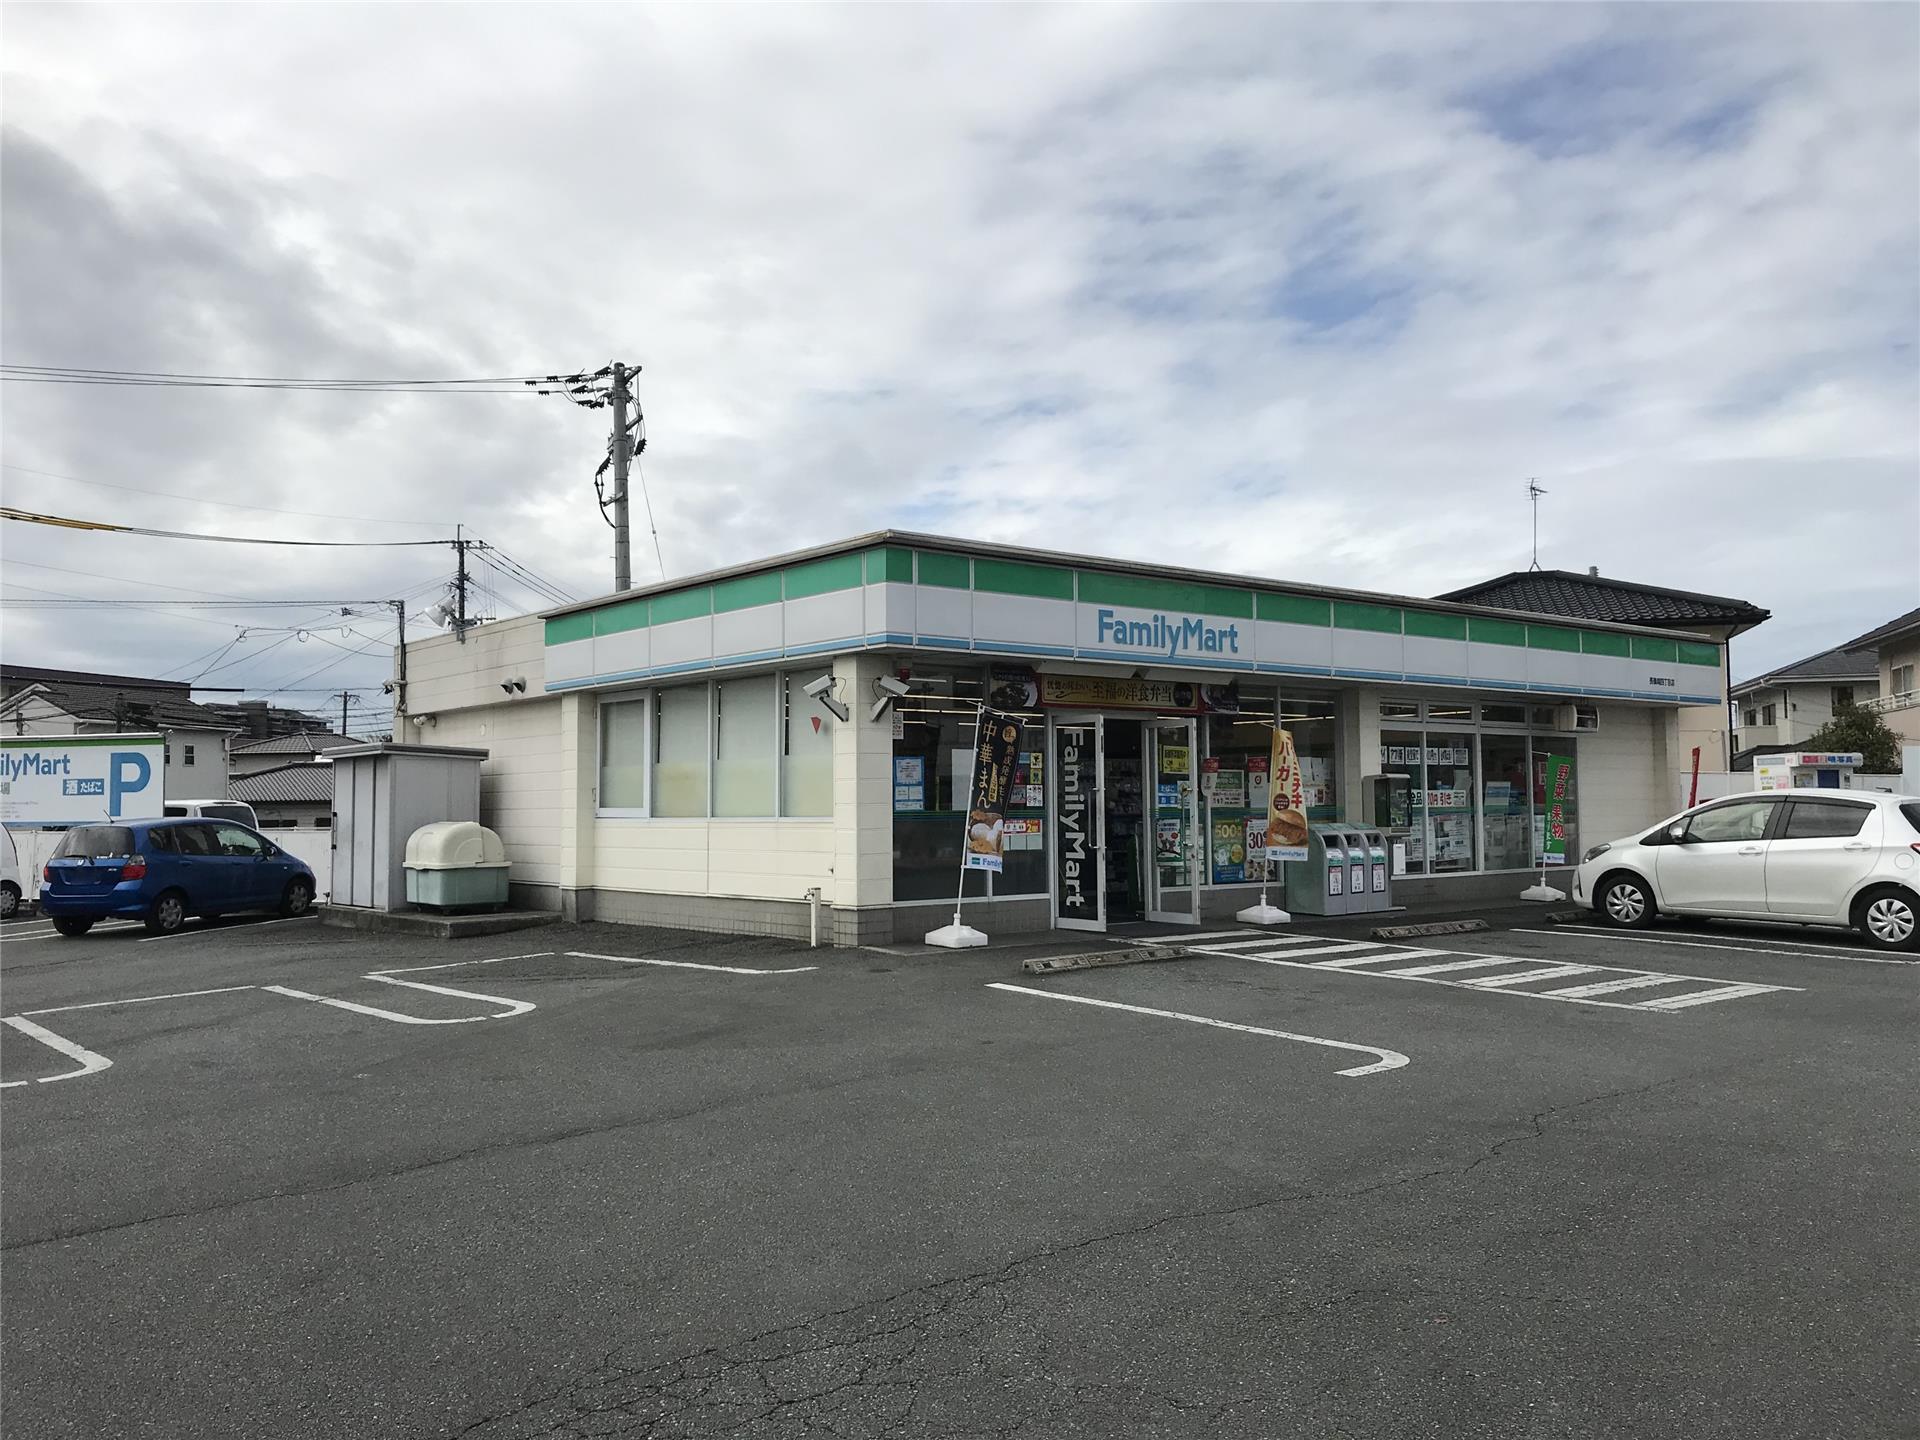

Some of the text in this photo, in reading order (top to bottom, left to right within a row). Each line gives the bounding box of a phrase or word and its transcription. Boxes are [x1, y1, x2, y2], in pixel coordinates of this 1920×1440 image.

[1098, 609, 1238, 658] FamilyMart
[66, 780, 102, 794] 酒 たばこ
[110, 752, 151, 816] P
[977, 720, 997, 809] 中華まん
[1553, 764, 1570, 800] 野菜
[1059, 729, 1086, 907] FamilyMart
[1551, 804, 1564, 840] 果物
